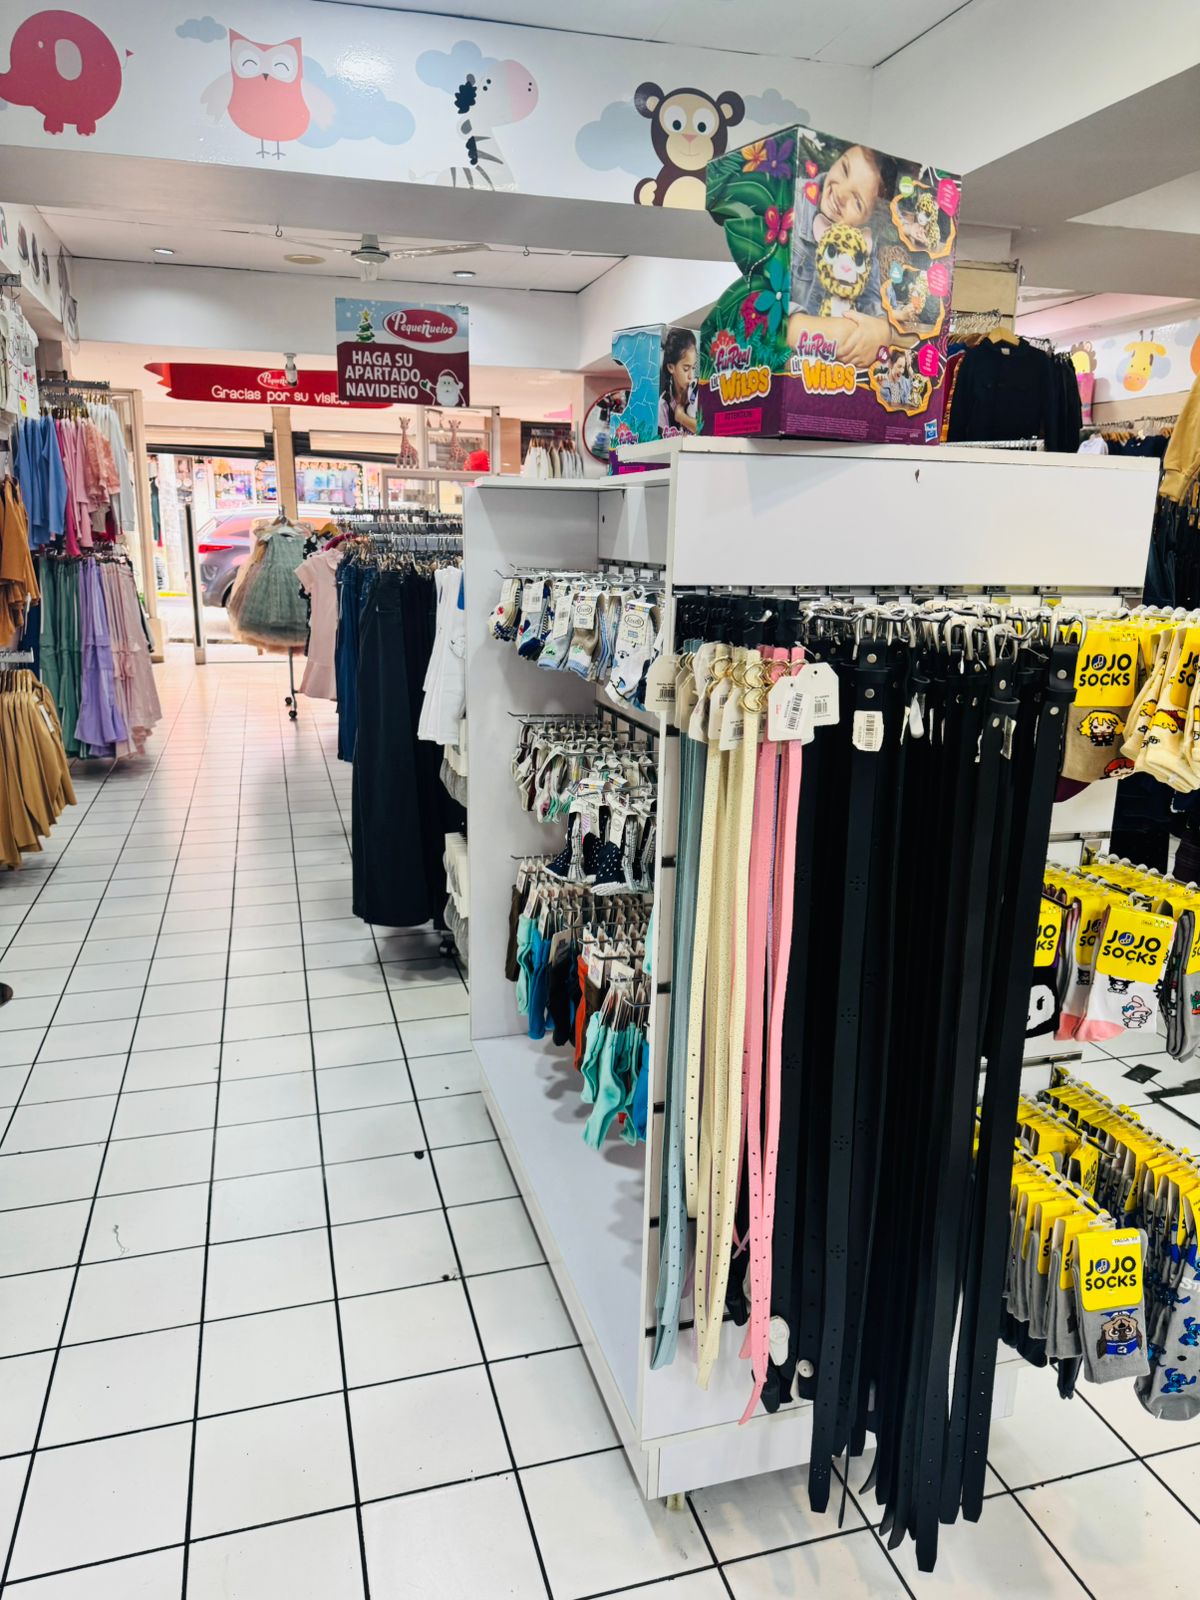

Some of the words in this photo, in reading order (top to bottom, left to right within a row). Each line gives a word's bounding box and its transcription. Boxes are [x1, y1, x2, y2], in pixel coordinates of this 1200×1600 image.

[391, 312, 453, 338] Pequeñuelos
[799, 331, 836, 360] furReal
[352, 351, 392, 366] HAGA
[395, 353, 413, 367] SU
[345, 365, 420, 382] APARTADO
[211, 385, 261, 400] Gracias
[267, 392, 290, 403] por
[294, 392, 309, 402] su
[346, 382, 419, 399] NAVIDEÑO
[1081, 653, 1132, 672] JOJO
[1079, 672, 1130, 687] SOCKS
[1106, 930, 1161, 952] JOJO
[1102, 945, 1157, 966] SOCKS
[1086, 1256, 1136, 1277] JOJO
[1085, 1275, 1137, 1291] SOCKS
